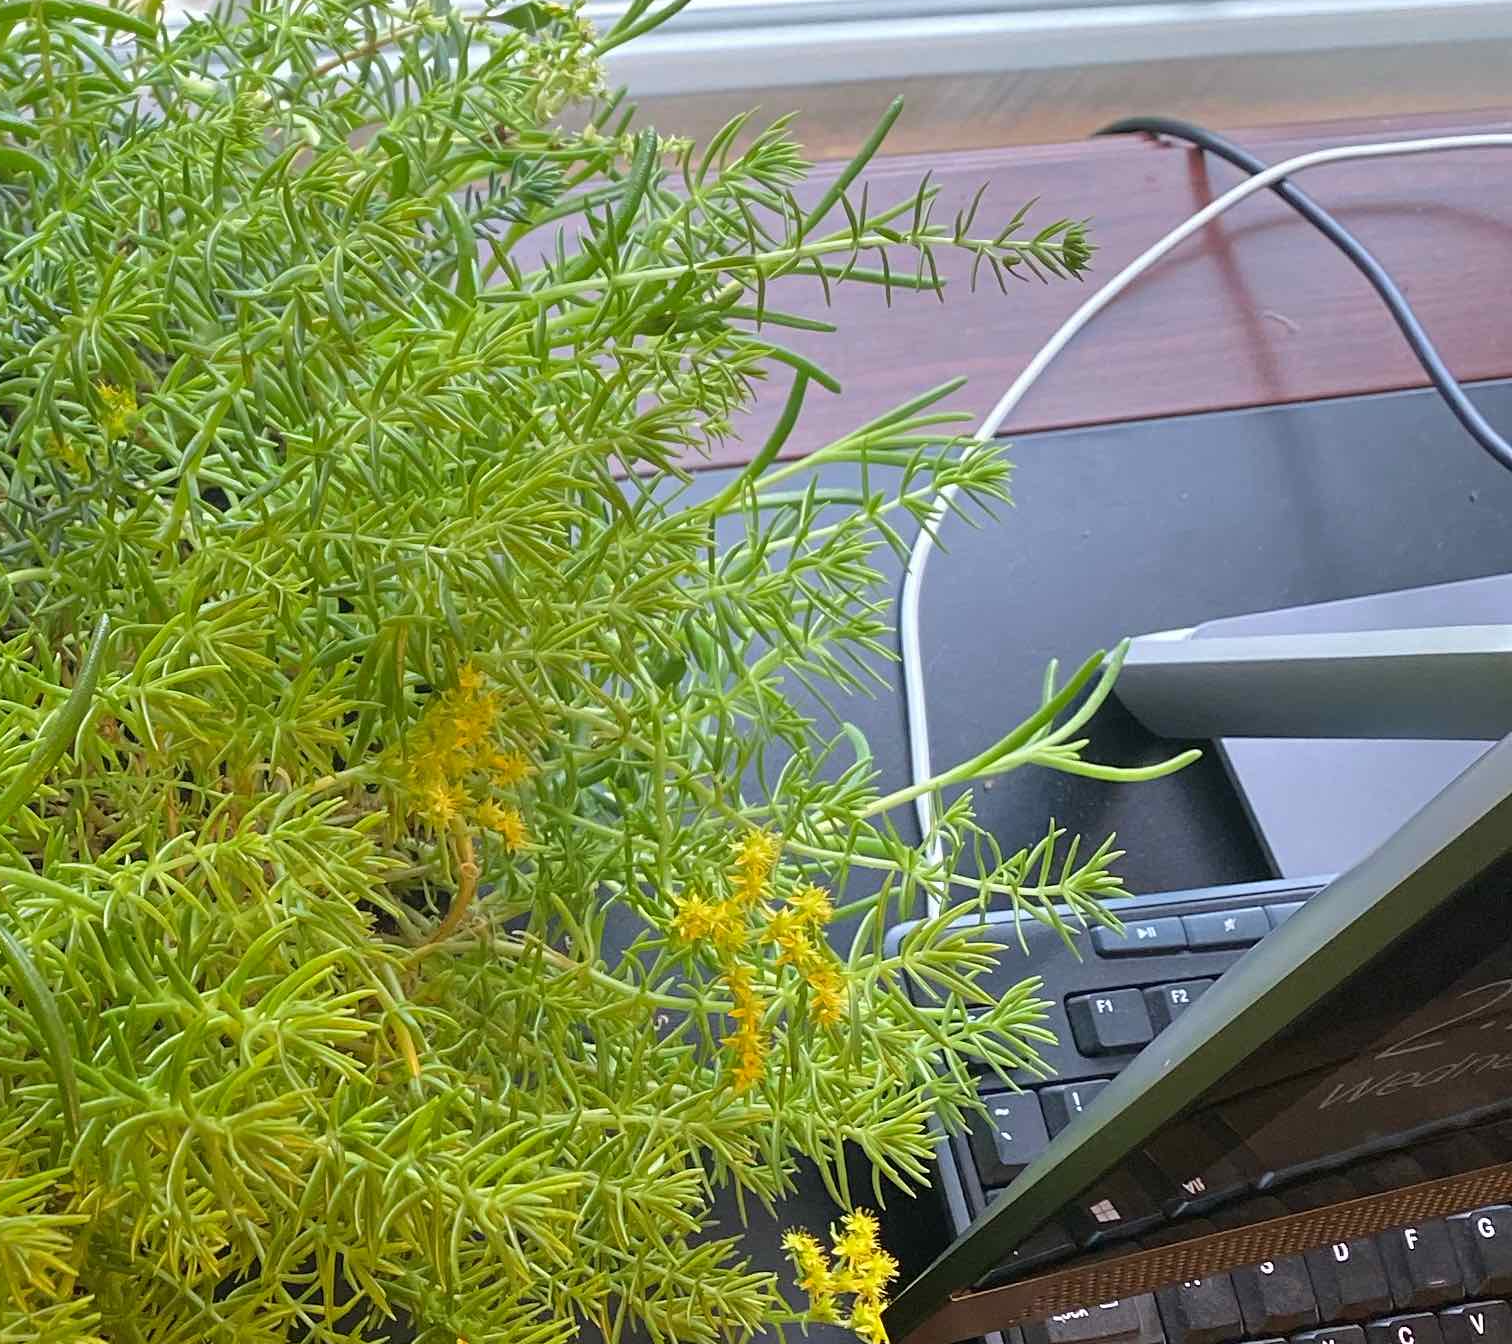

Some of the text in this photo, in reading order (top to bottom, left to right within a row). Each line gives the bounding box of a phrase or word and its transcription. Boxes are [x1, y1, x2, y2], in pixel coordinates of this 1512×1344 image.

[1170, 989, 1190, 1004] F2
[1095, 999, 1114, 1014] F1
[1332, 1242, 1350, 1263] D
[1404, 1228, 1419, 1250] F
[1477, 1216, 1496, 1239] G
[1469, 1312, 1485, 1335] V
